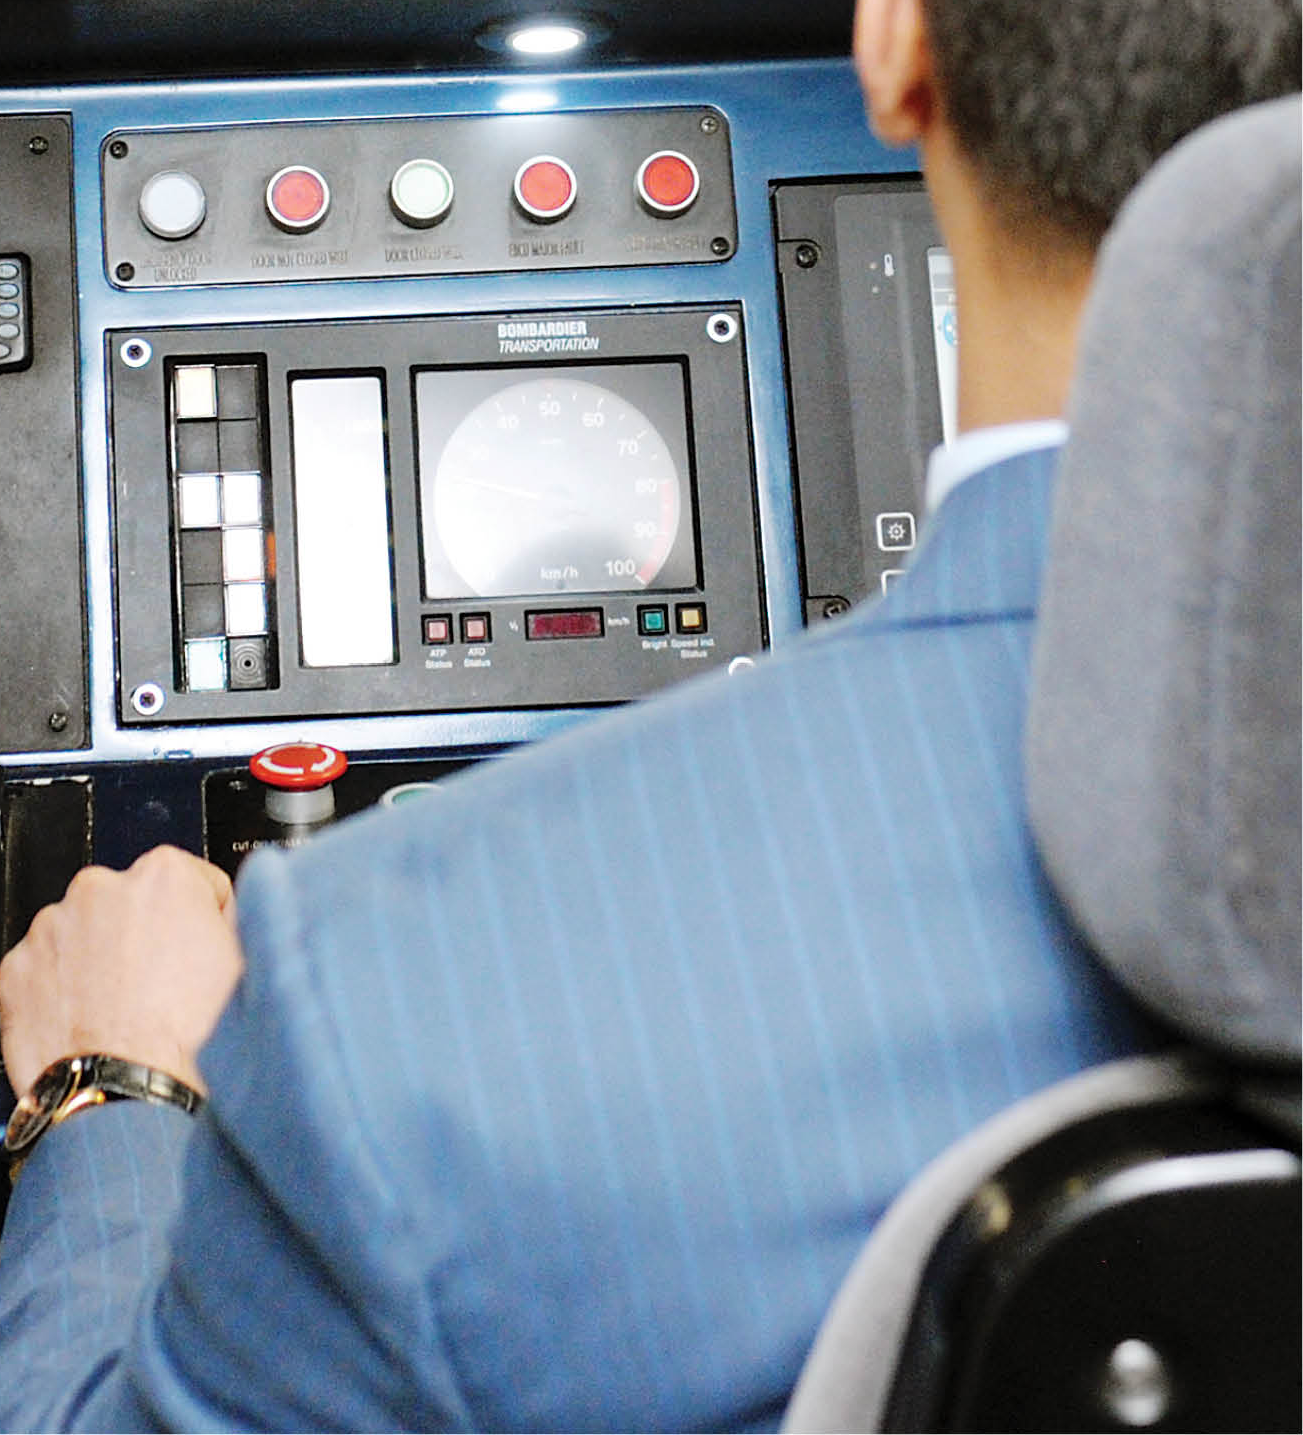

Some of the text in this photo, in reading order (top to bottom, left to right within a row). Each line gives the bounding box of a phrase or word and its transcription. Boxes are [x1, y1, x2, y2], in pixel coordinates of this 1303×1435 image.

[497, 320, 587, 338] BOMBARDIER
[499, 337, 600, 354] TRANSPORTATION
[538, 402, 561, 416] 50
[581, 413, 605, 428] 60
[617, 439, 639, 455] 70
[539, 566, 579, 582] km/h
[605, 560, 636, 576] 100
